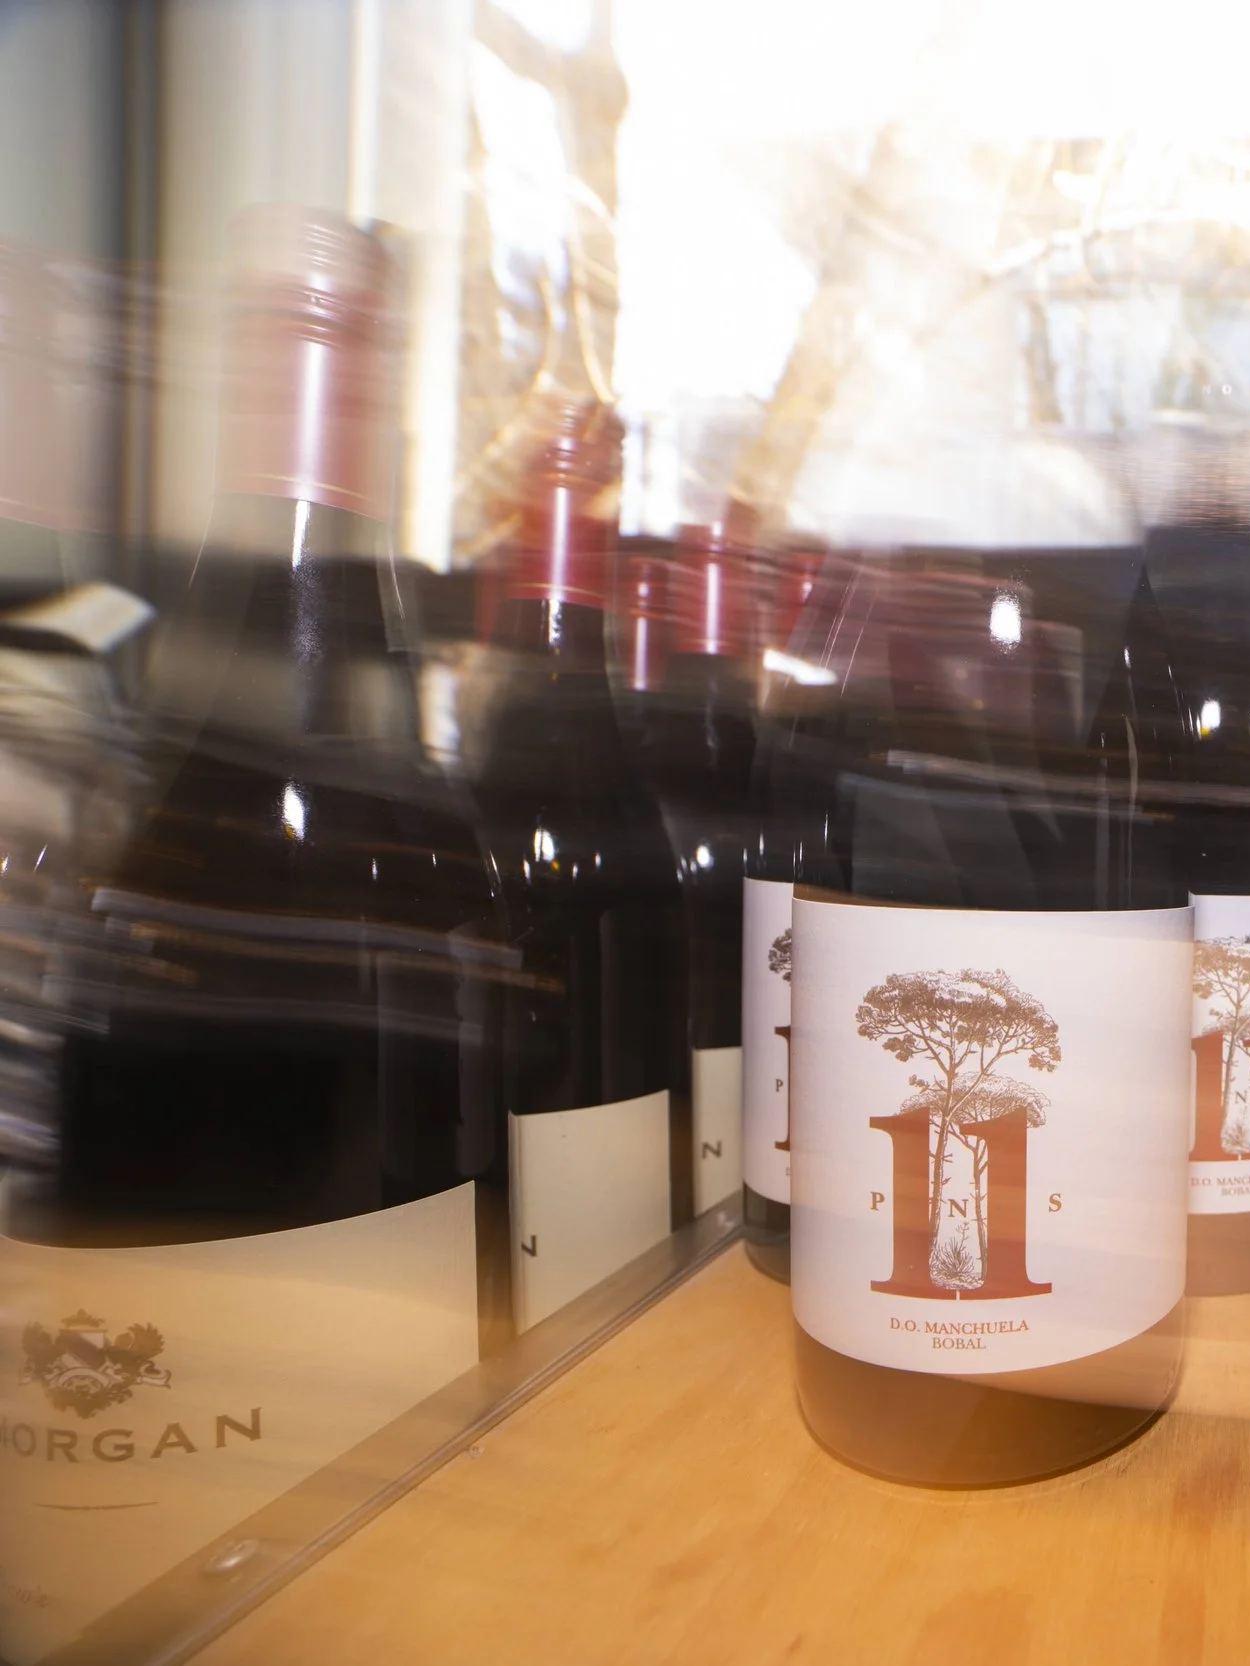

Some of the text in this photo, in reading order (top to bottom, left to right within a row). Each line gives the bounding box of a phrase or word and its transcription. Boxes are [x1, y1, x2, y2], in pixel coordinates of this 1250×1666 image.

[775, 1078, 784, 1093] P
[869, 1191, 1063, 1218] P N S
[890, 1317, 1029, 1336] D.O. MANCHUELA
[932, 1336, 987, 1351] BOBAL
